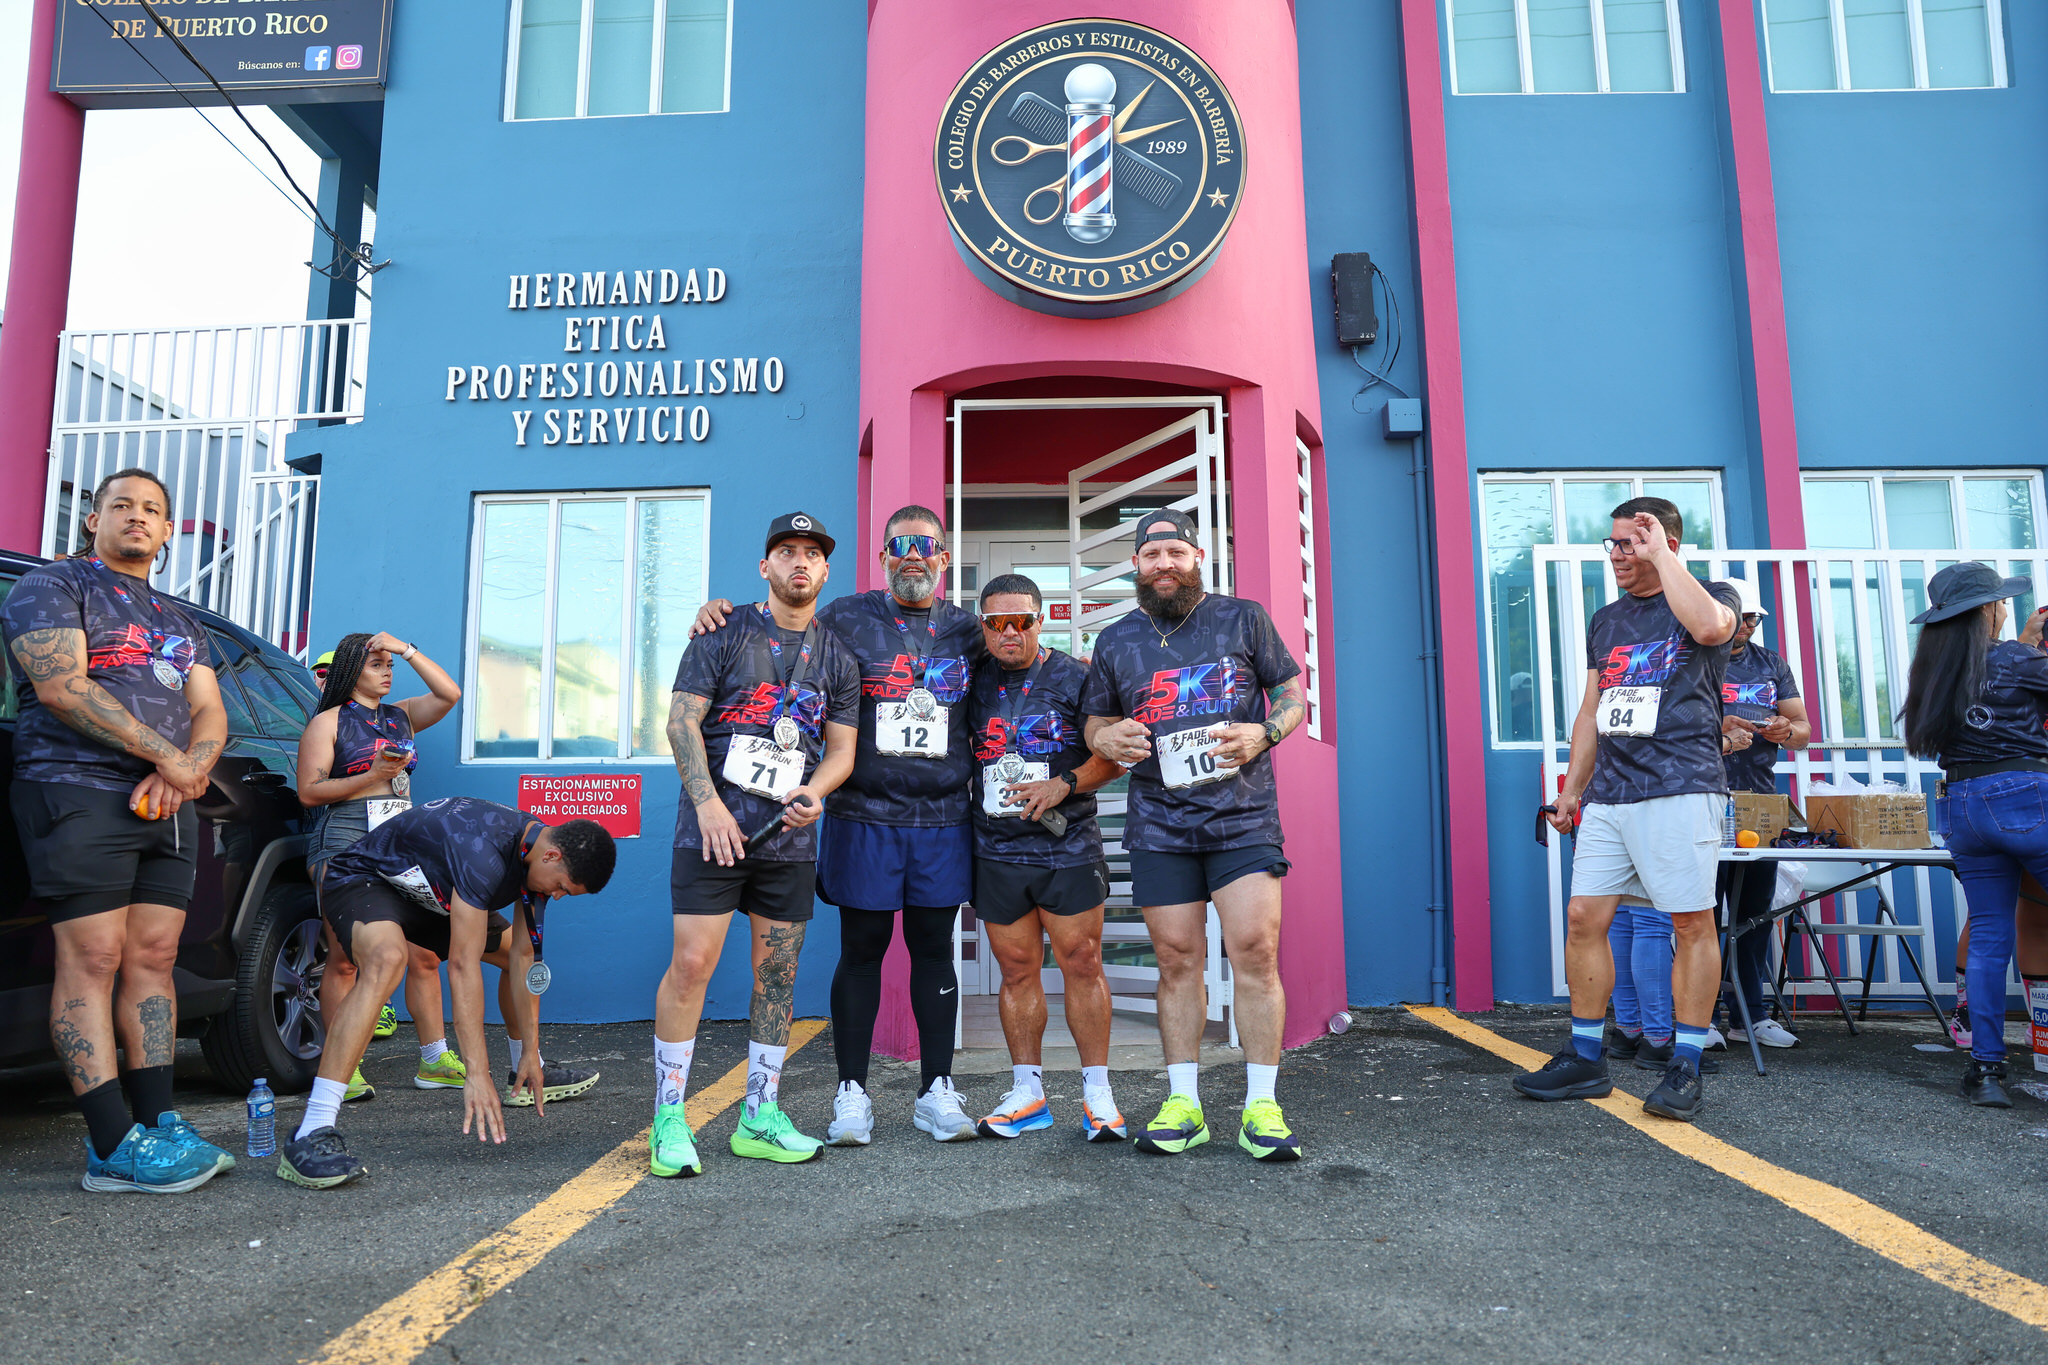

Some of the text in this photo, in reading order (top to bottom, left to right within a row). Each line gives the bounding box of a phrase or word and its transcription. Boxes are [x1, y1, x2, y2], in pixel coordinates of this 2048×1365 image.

[111, 12, 329, 39] DE PUERTO RICO
[238, 61, 283, 70] Búscanos
[948, 32, 1234, 170] COLEGIO DE BARBEROS Y ESTILISTAS EN BARBERÍA
[1146, 140, 1187, 155] 1989
[986, 236, 1191, 288] PUERTO RICO
[508, 267, 727, 309] HERMANDAD
[564, 314, 667, 352] ETICA
[445, 356, 784, 400] PROFESIONALISMO
[512, 405, 710, 445] Y SERVICIO
[89, 654, 149, 669] FADE
[1604, 641, 1666, 675] 5K
[884, 654, 957, 690] 5K
[1598, 669, 1669, 689] ADE & RUN
[862, 684, 966, 703] FADE RUN
[1149, 663, 1218, 707] 5K
[1616, 689, 1639, 697] FADE
[1721, 683, 1767, 704] 5K
[718, 711, 770, 725] FADE
[1176, 705, 1190, 717] &
[1192, 700, 1233, 715] RUN
[1609, 708, 1634, 727] 84
[901, 726, 928, 748] 12
[984, 715, 1047, 748] 5K
[1182, 728, 1208, 743] FADE
[1023, 741, 1061, 755] RUN
[771, 753, 792, 765] RUN
[1184, 752, 1215, 778] 10
[522, 779, 637, 790] ESTACIONAMIENTO
[751, 762, 778, 788] 71
[545, 791, 614, 801] EXCLUSIVO
[530, 804, 628, 815] PARA COLEGIADOS
